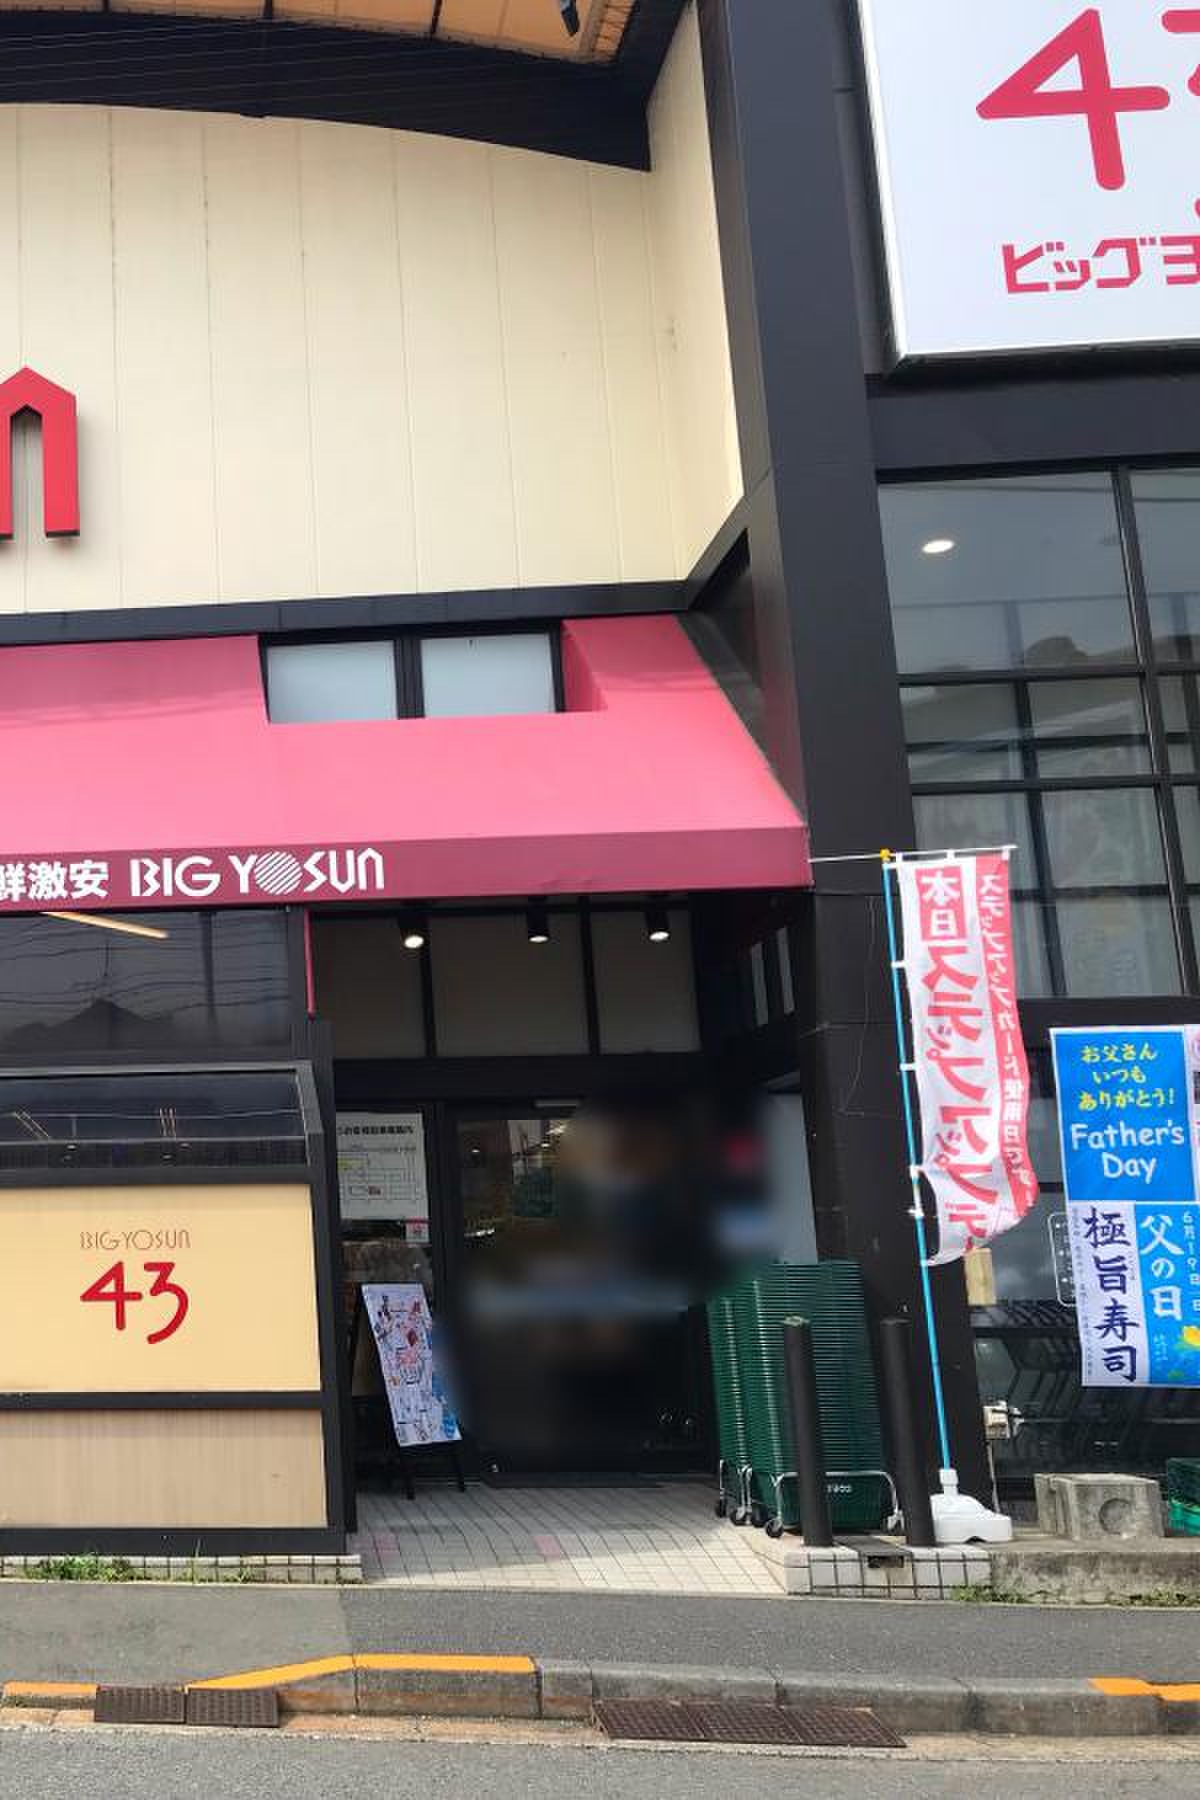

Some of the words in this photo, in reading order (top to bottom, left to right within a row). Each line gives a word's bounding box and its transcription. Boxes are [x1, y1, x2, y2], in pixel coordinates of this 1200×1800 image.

[975, 8, 1200, 218] 4
[130, 855, 221, 897] BIG
[228, 847, 385, 895] YOSUN
[1081, 1042, 1158, 1063] お父さん
[1093, 1065, 1146, 1084] いつも
[1071, 1120, 1185, 1150] Father's
[1102, 1152, 1158, 1184] Day
[1140, 1214, 1184, 1321] 父の日
[80, 1261, 189, 1344] 43
[1082, 1205, 1140, 1382] 極旨寿司
